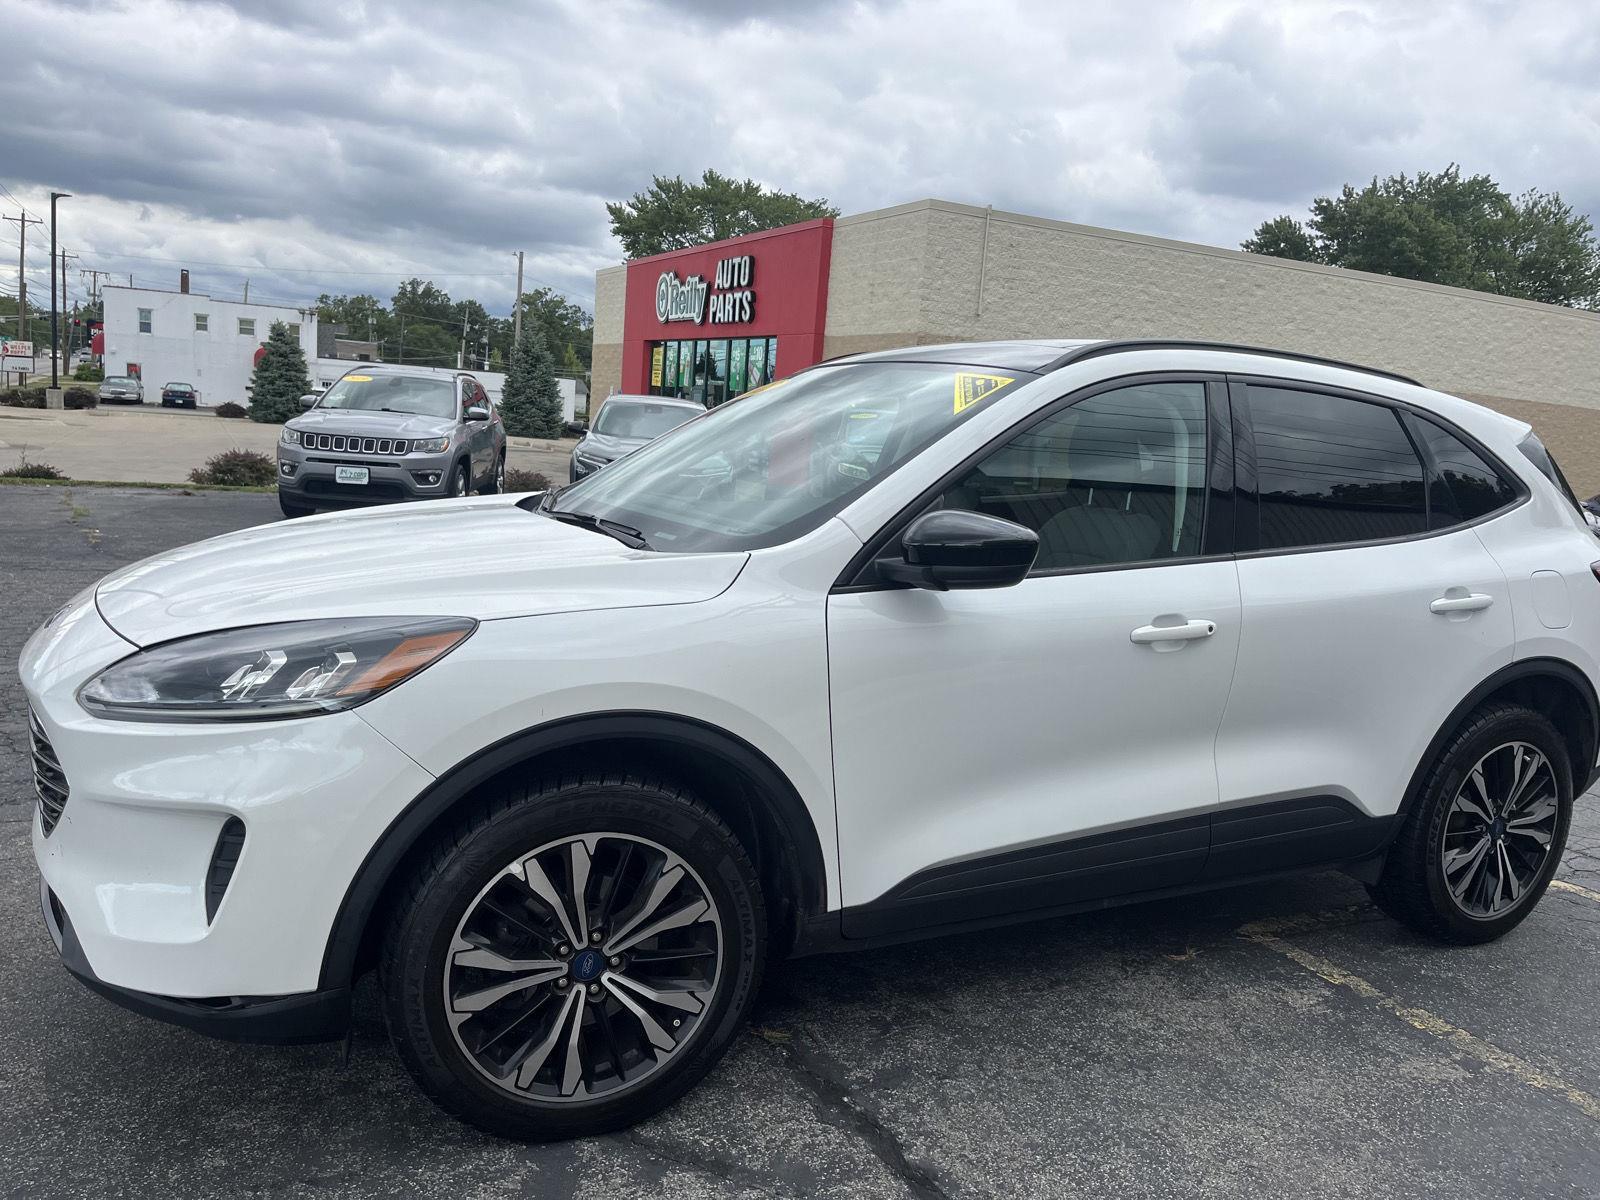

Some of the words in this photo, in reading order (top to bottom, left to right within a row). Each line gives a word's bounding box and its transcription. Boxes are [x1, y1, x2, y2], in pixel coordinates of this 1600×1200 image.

[714, 255, 750, 290] AUTO
[655, 271, 707, 324] O'Reilly
[709, 290, 752, 323] PARTS
[554, 798, 672, 826] GENERAL
[728, 879, 754, 964] ALTIMAX
